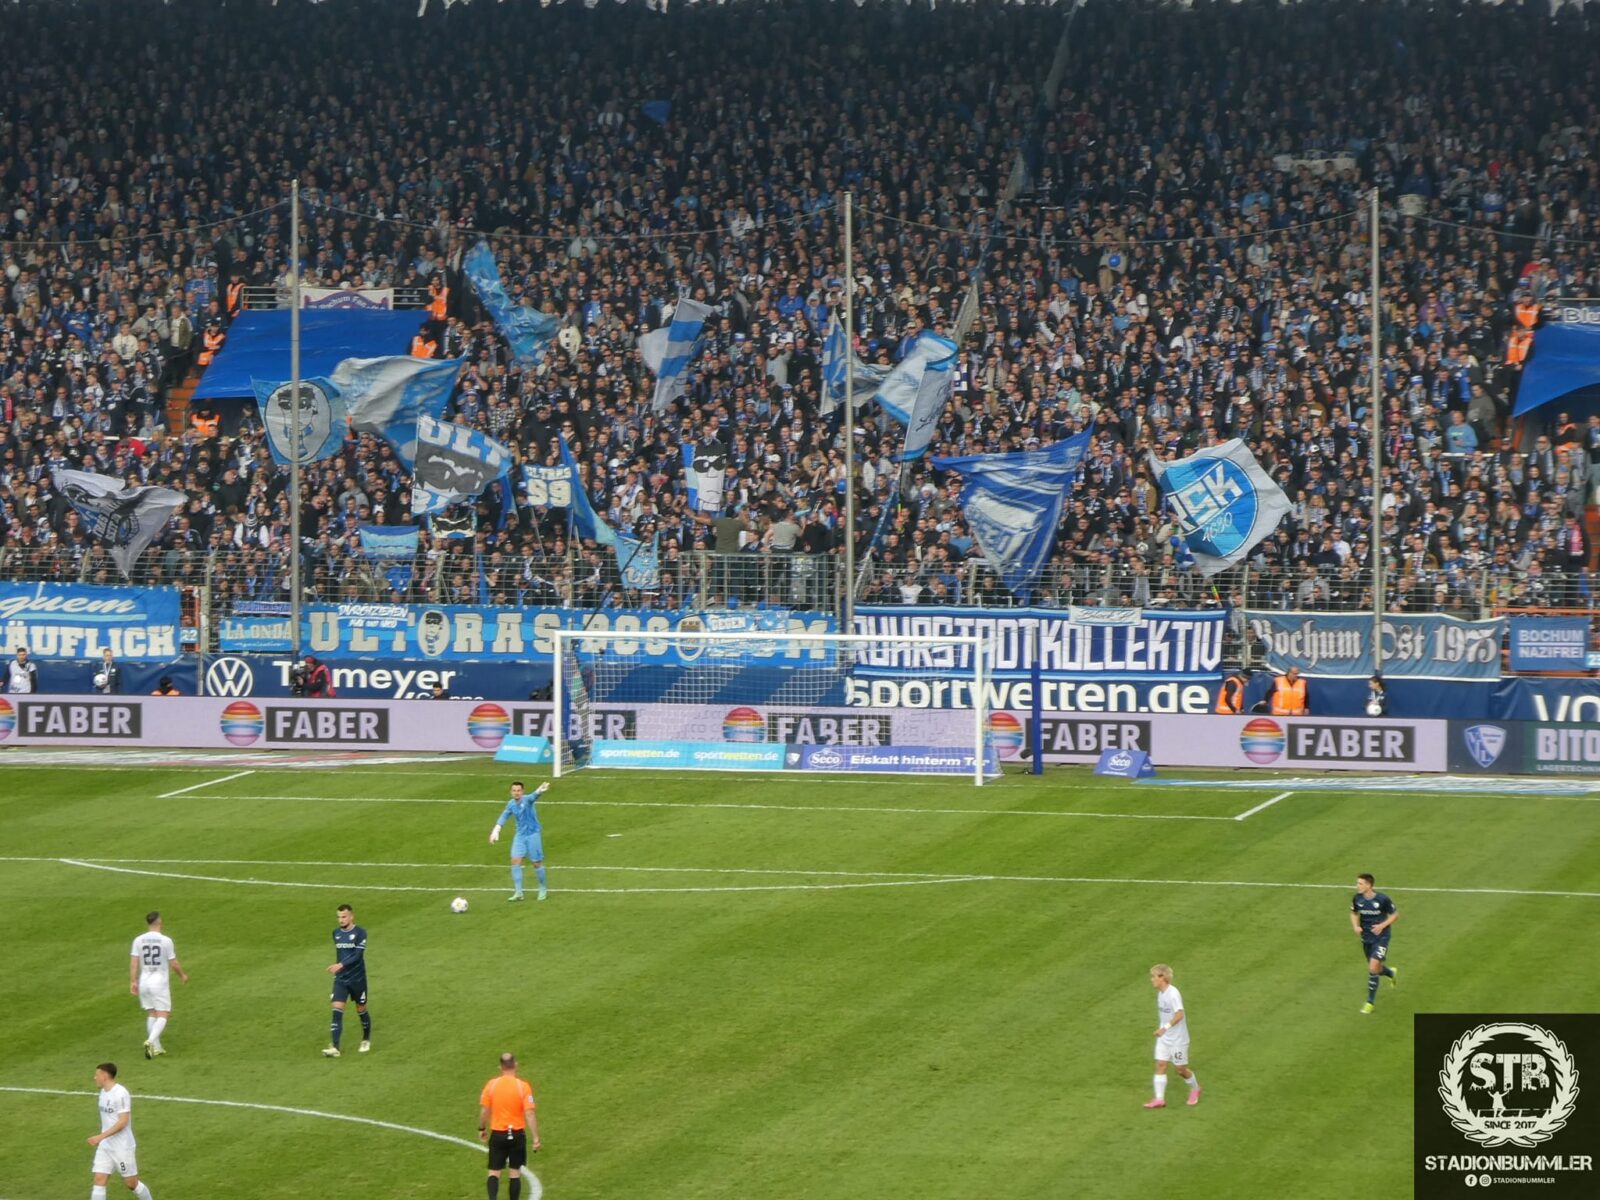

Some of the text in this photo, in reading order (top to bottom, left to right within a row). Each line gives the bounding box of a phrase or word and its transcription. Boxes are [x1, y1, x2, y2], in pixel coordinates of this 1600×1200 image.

[0, 620, 176, 657] ÄUFLICH
[181, 629, 198, 642] 22
[1250, 619, 1361, 669] Bochum
[1434, 624, 1498, 664] 1975
[1519, 629, 1584, 642] BOCHUM
[1519, 646, 1584, 658] NAZIFREI
[845, 680, 1210, 714] sportwetten.de
[27, 705, 132, 734] FABER
[275, 711, 380, 741] FABER
[777, 717, 882, 746] FABER
[1040, 722, 1141, 751] FABER
[1297, 727, 1405, 760] FABER
[600, 749, 681, 759] sportwetten.de
[694, 750, 779, 762] sportwetten.de
[811, 753, 840, 765] Seco
[851, 755, 900, 765] Eiskalt
[901, 755, 961, 766] hinterm
[142, 945, 161, 965] 22
